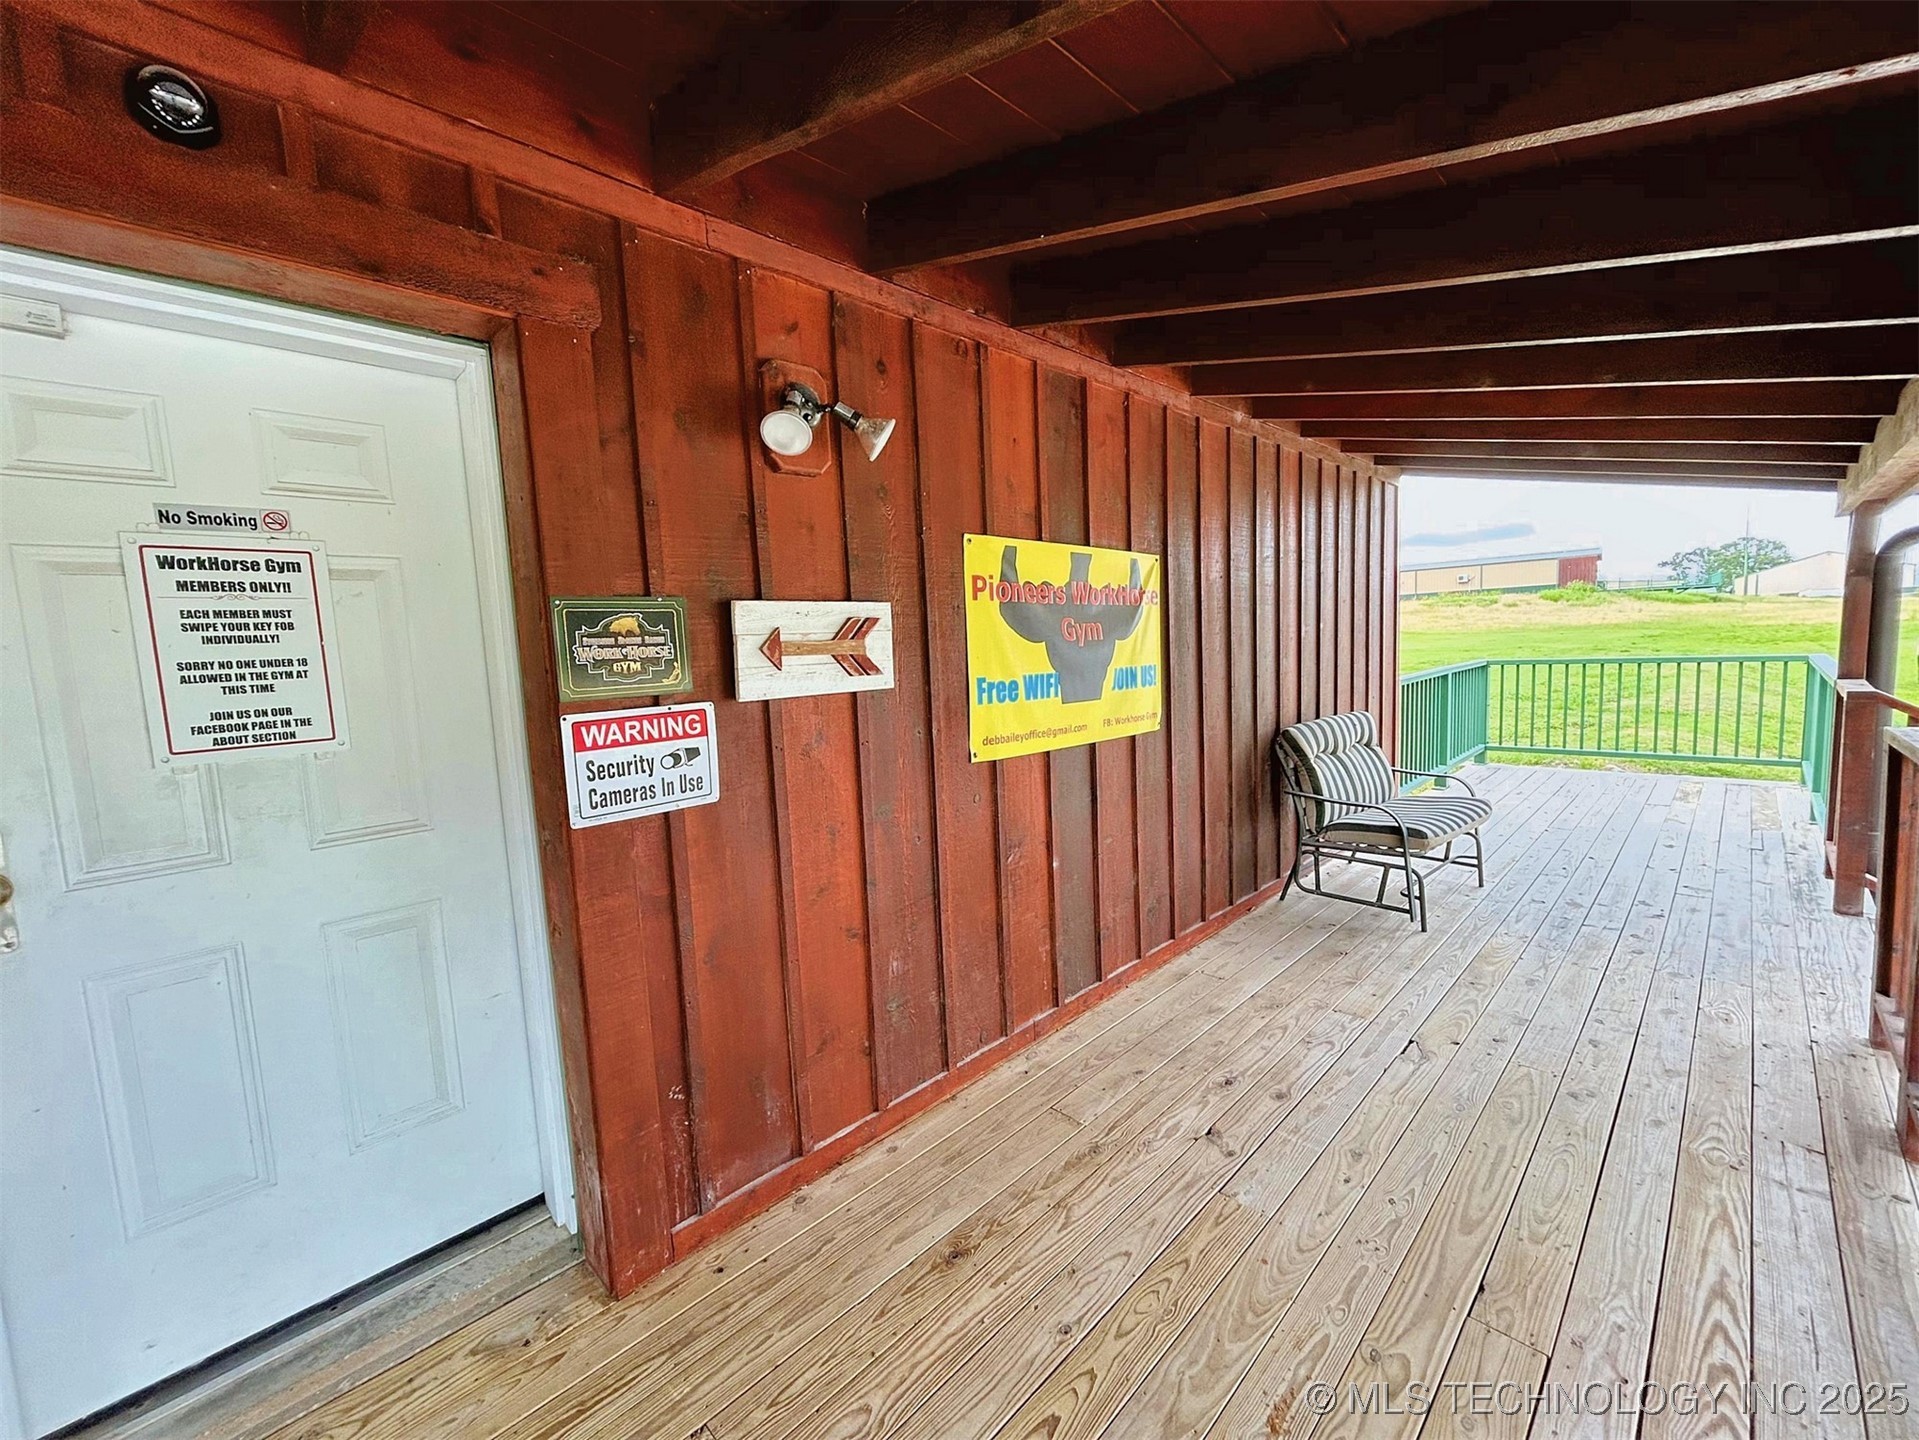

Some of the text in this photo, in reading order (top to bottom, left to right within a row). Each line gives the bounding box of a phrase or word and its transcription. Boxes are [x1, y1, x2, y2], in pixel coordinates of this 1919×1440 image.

[157, 509, 258, 531] No Smoking
[155, 555, 302, 573] WorkHorse Gym
[175, 580, 292, 594] MEMBERS ONLY!!
[971, 575, 1067, 606] Pioneers
[179, 609, 293, 619] EACH MEMBER MUST
[180, 622, 295, 632] SWIPE YOUR KEY FOB
[1061, 616, 1104, 648] Gym
[201, 634, 280, 645] INDIVIDUALLY!
[176, 657, 308, 671] SORRY NO ONE UNDER 18
[612, 661, 642, 673] GYM
[179, 669, 309, 684] ALLOWED IN THE GYM AT
[1111, 664, 1157, 691] JOIN US!
[220, 683, 276, 695] THIS TIME
[976, 672, 1060, 706] Free WIFI
[209, 707, 293, 721] JOIN US ON OUR
[1103, 718, 1114, 728] FB:
[1114, 714, 1146, 725] Workhorse
[190, 717, 313, 735] FACEBOOK PAGE IN THE
[580, 714, 702, 748] WARNING
[212, 731, 297, 746] ABOUT SECTION
[982, 723, 1088, 746] debbaileyoffice@gmail.com
[586, 754, 655, 782] Security
[588, 773, 704, 810] Cameras In Use
